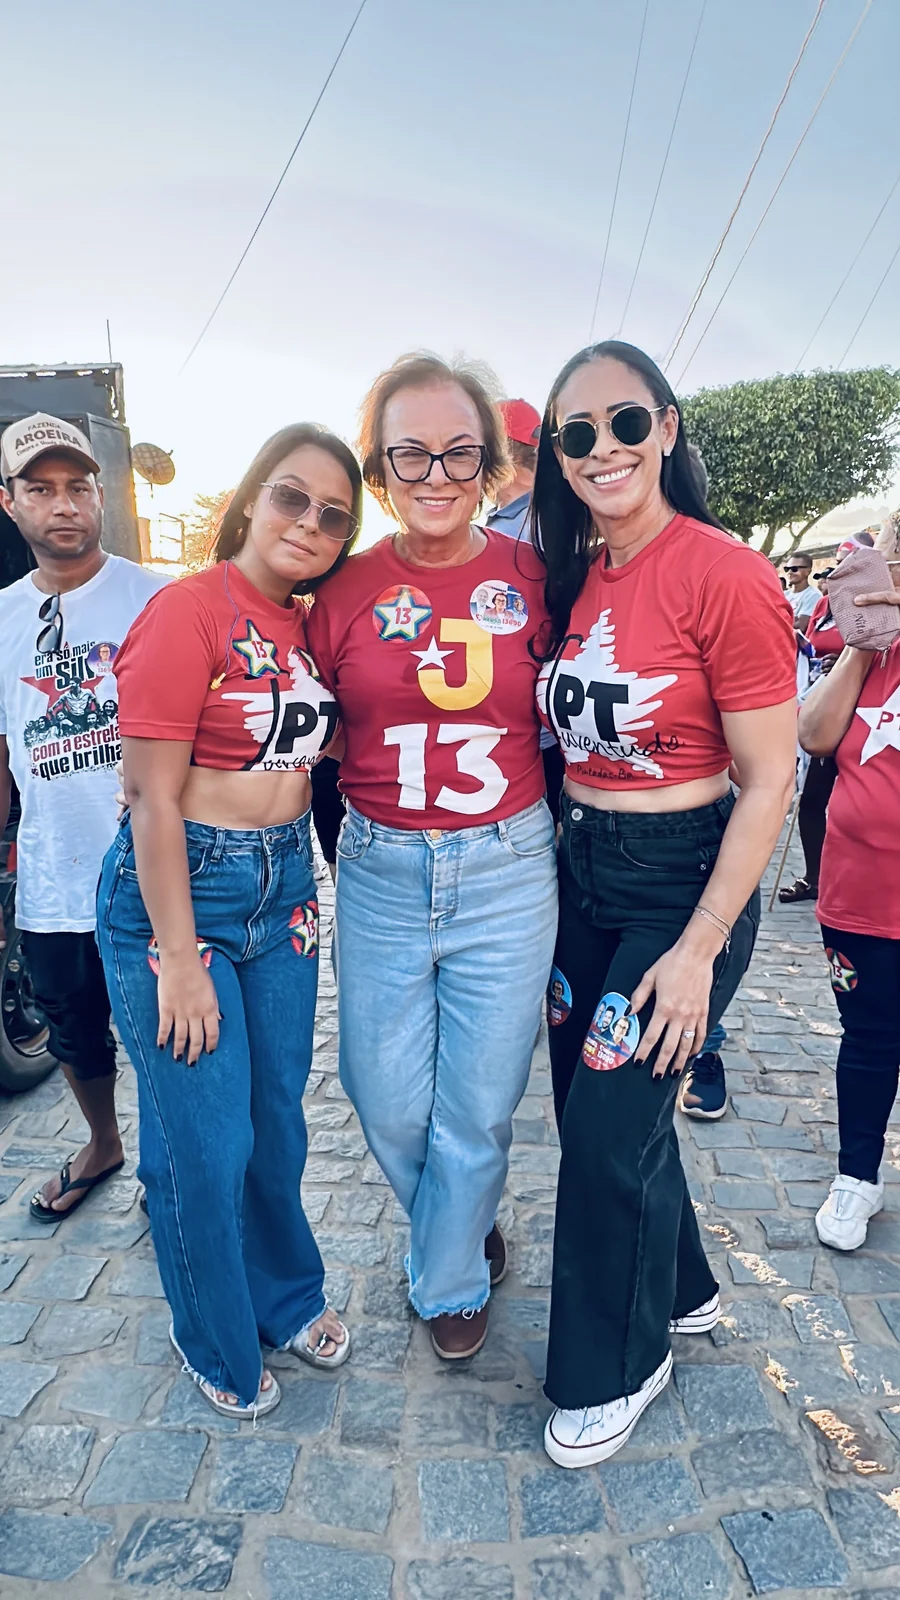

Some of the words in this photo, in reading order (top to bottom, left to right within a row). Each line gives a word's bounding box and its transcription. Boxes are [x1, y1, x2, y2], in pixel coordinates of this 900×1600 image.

[28, 422, 61, 432] FAZENDA
[15, 430, 81, 450] AROEIRA
[395, 607, 411, 624] 13
[34, 651, 54, 667] era
[251, 640, 268, 659] 13
[36, 664, 53, 679] um
[553, 673, 629, 743] PT
[274, 701, 341, 754] PT
[33, 745, 60, 762] com
[63, 738, 71, 753] a
[40, 756, 70, 781] que
[383, 723, 509, 815] 13
[305, 919, 316, 939] 13
[833, 964, 843, 978] 13
